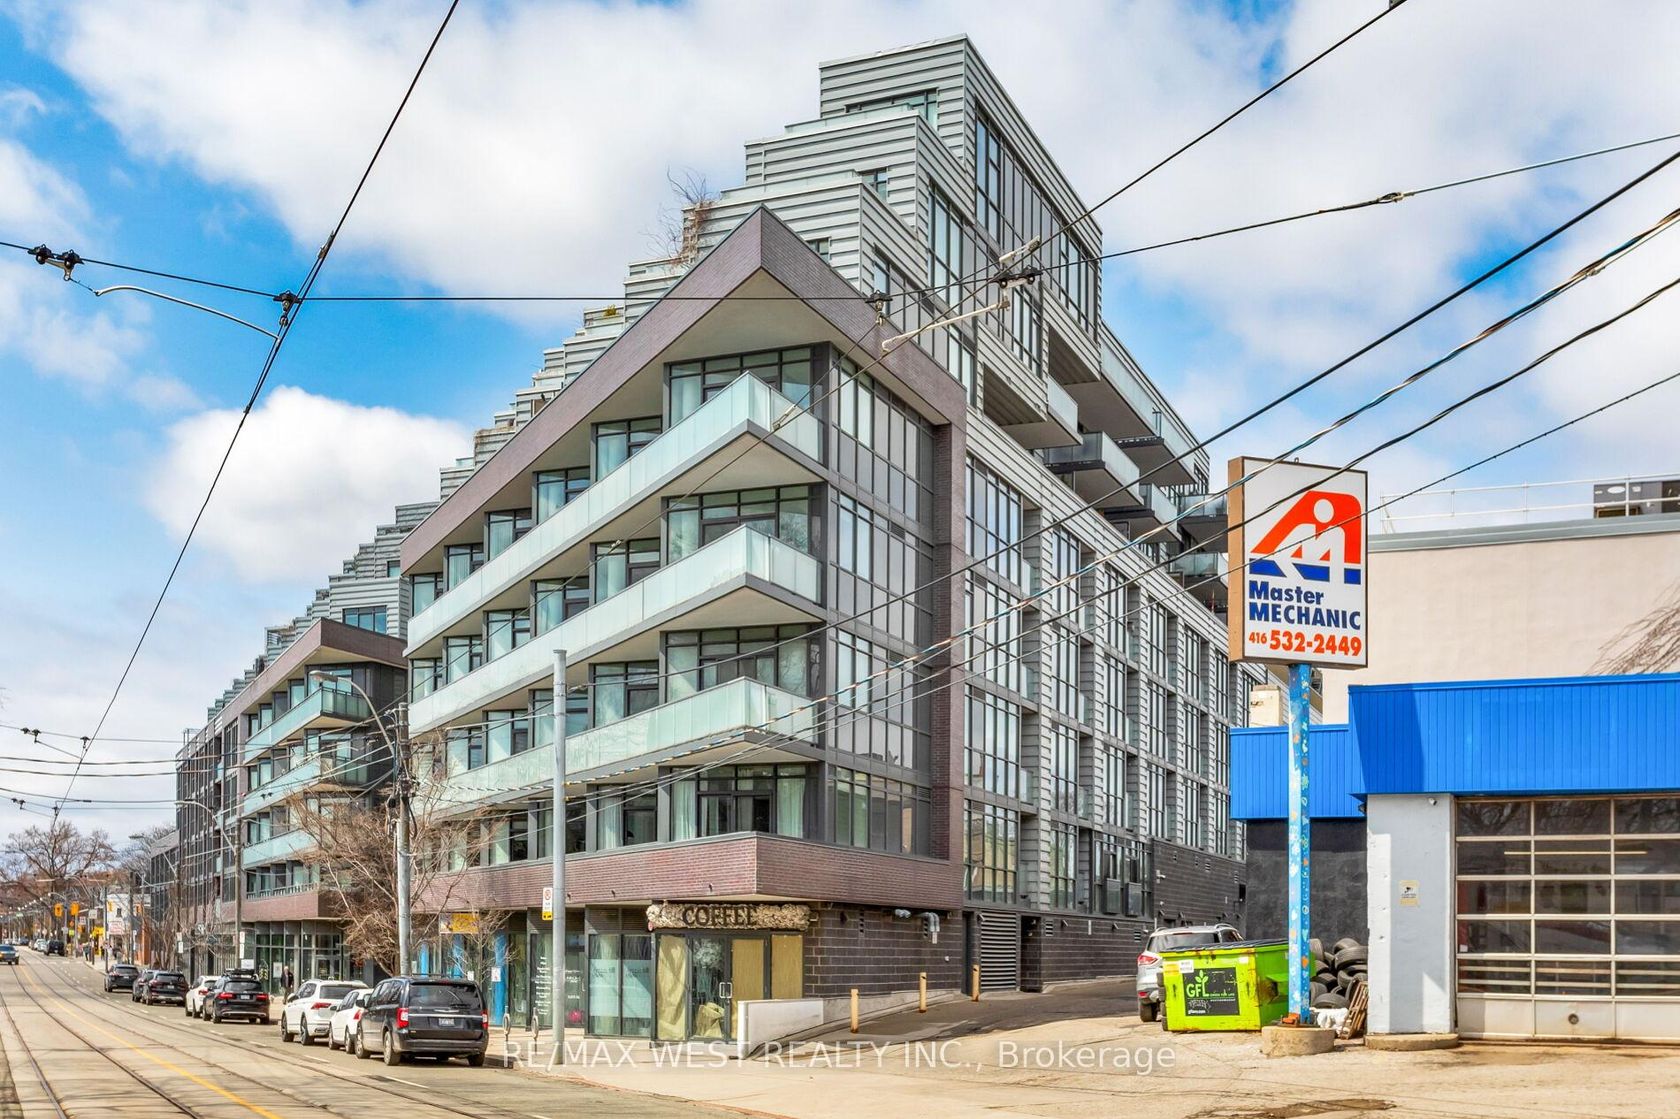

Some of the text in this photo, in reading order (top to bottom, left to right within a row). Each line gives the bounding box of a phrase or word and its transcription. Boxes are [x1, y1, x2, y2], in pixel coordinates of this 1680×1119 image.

[1249, 580, 1324, 604] Master
[1249, 602, 1361, 630] MECHANIC
[1249, 630, 1362, 656] 416 532-2449
[682, 905, 757, 926] COFFEE
[1186, 977, 1209, 997] GFL
